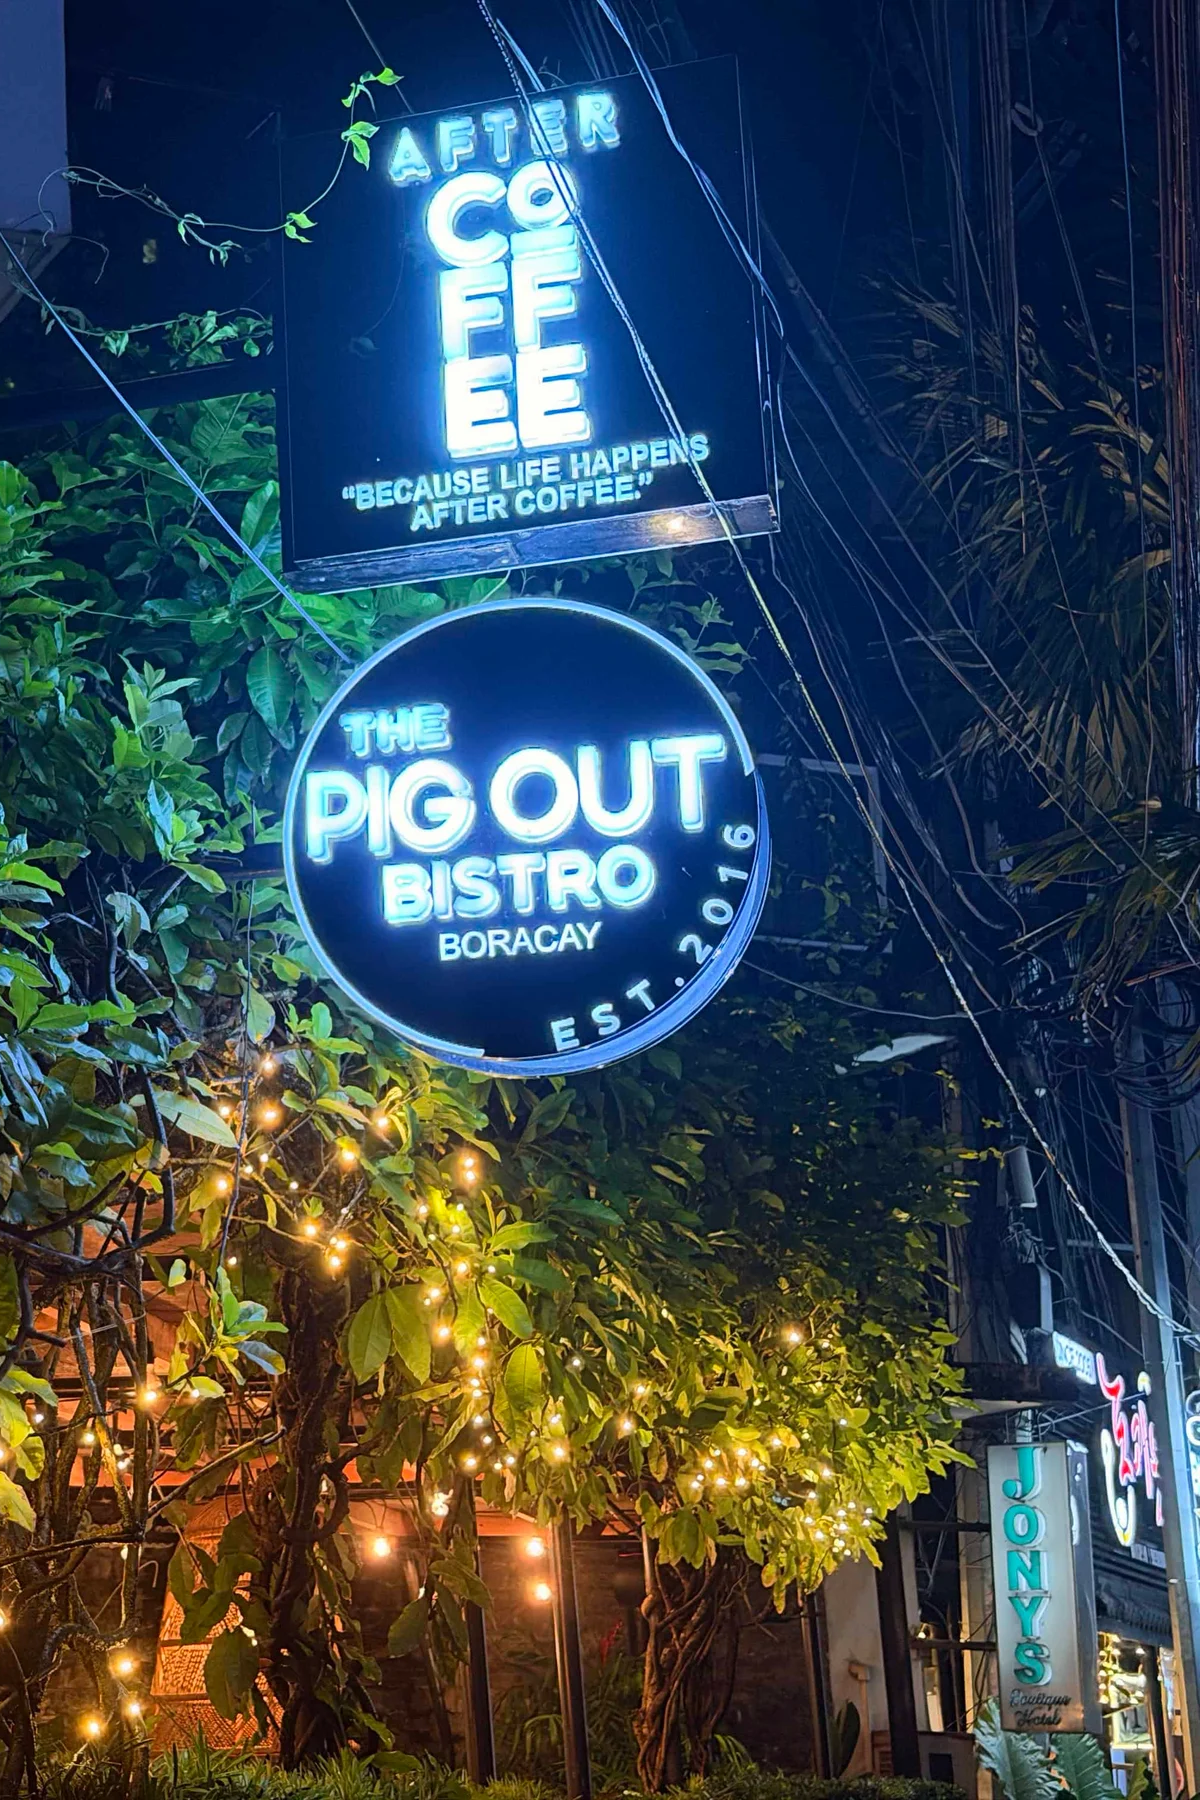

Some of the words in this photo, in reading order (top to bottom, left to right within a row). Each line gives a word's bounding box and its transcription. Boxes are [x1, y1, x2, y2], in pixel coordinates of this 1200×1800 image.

[387, 90, 621, 184] AFTER
[499, 457, 562, 484] LIFE
[569, 434, 710, 475] HAPPENS
[409, 496, 509, 532] AFTER
[338, 702, 452, 757] THE
[305, 757, 476, 863] PIG
[489, 733, 727, 843] OUT
[380, 843, 656, 925] BISTRO
[438, 922, 601, 962] BORACAY
[1002, 1446, 1053, 1687] JONYS
